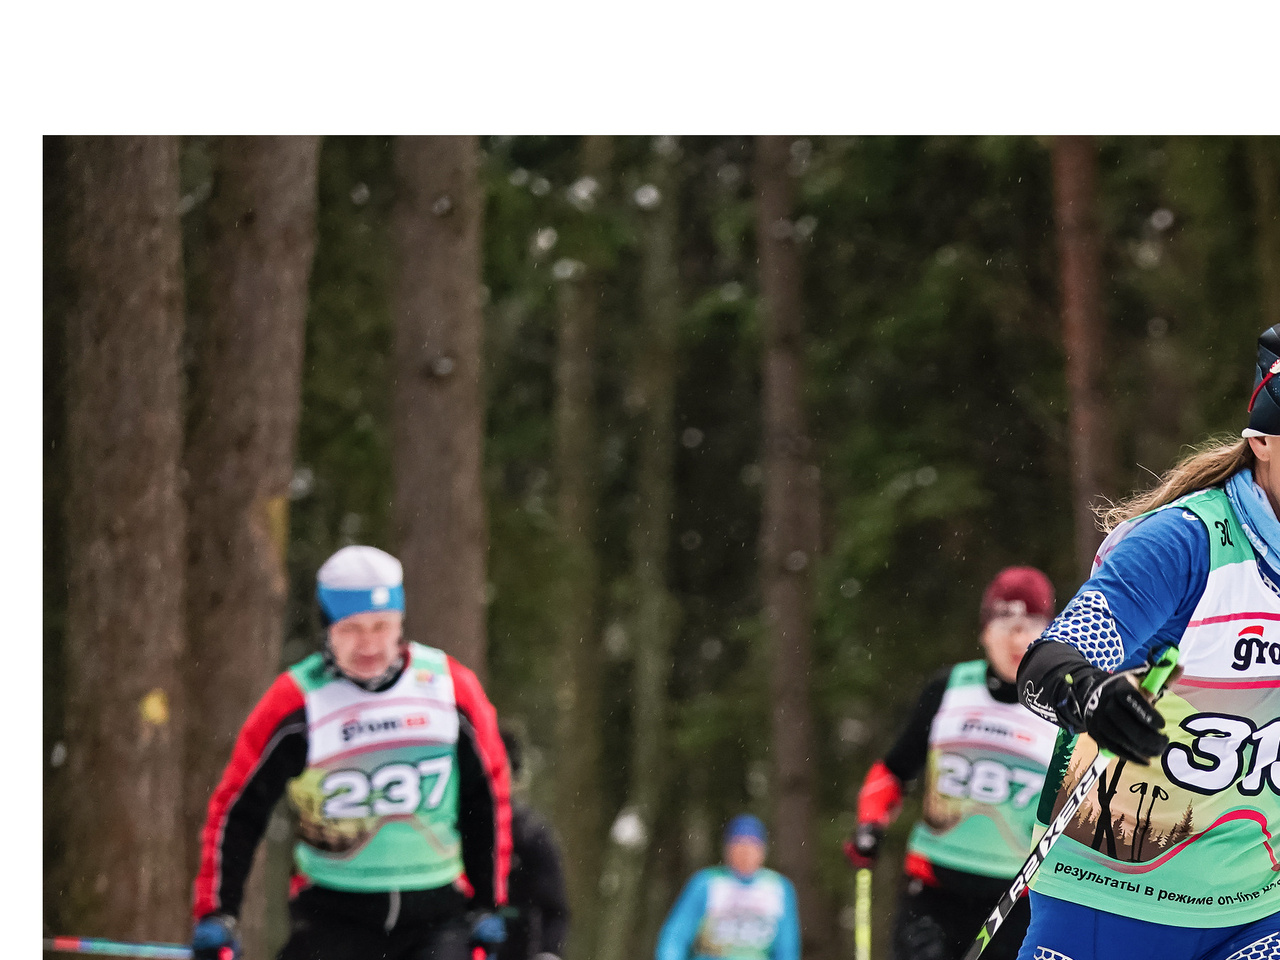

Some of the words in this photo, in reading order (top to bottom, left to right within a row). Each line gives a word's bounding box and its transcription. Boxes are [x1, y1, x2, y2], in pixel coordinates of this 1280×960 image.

[320, 752, 455, 819] 237
[936, 752, 1047, 808] 287
[1054, 861, 1140, 893] результаты
[1144, 886, 1154, 896] в
[1157, 889, 1213, 906] режиме
[1217, 890, 1260, 906] on-line
